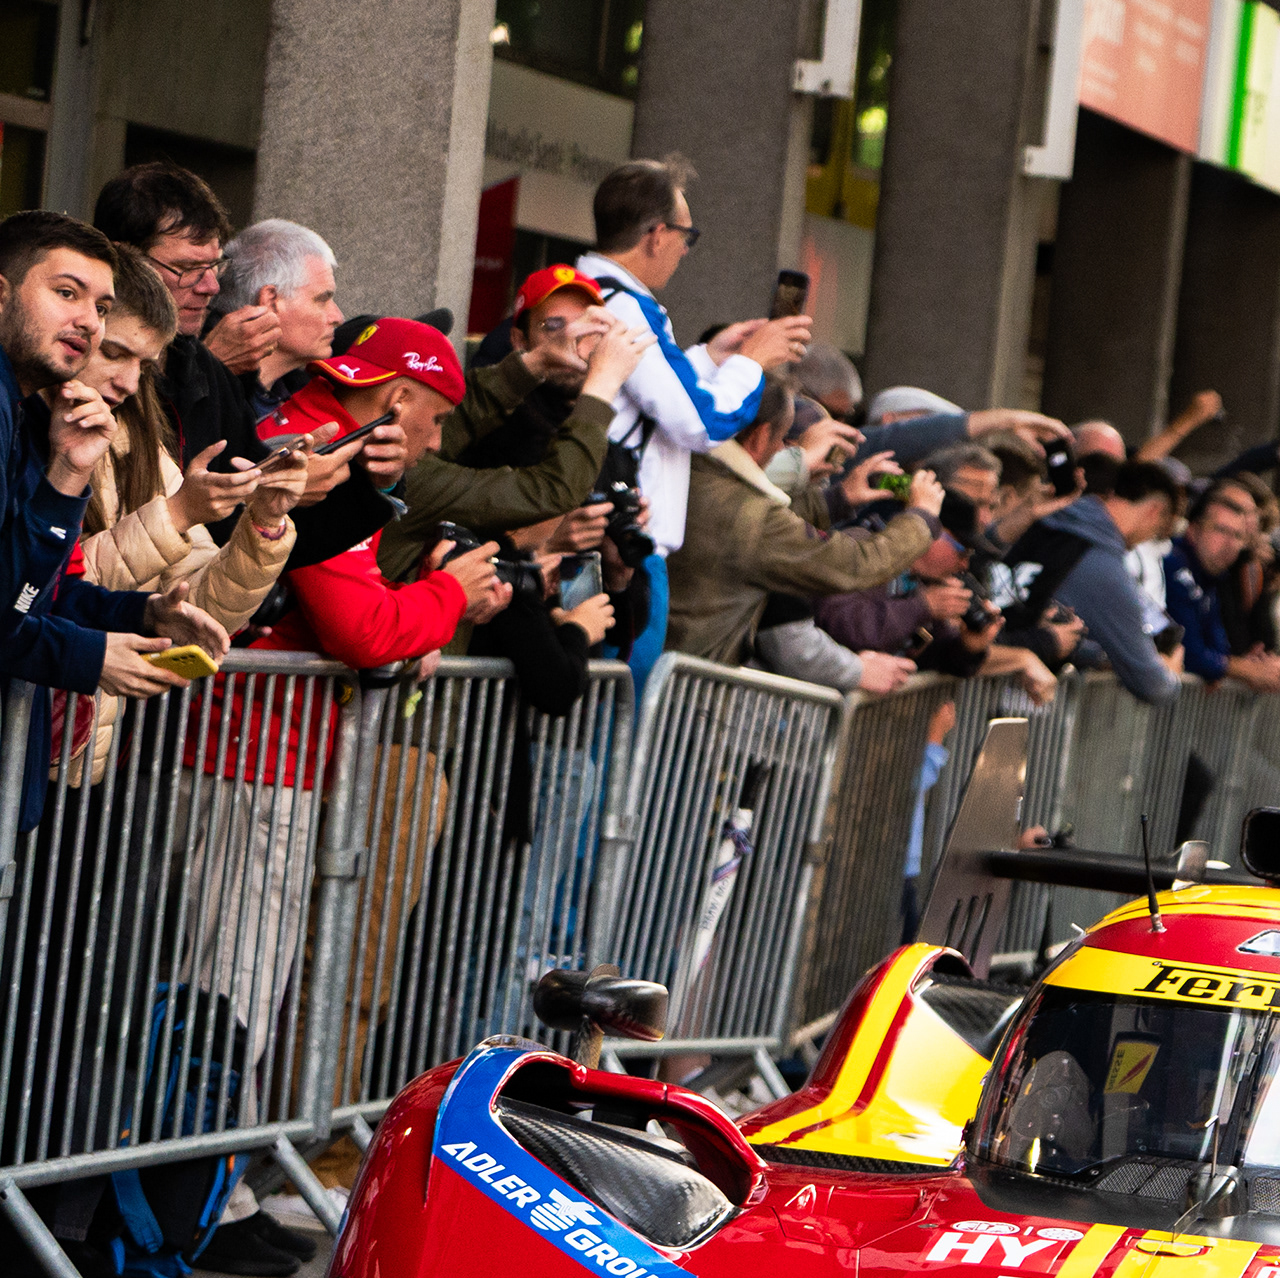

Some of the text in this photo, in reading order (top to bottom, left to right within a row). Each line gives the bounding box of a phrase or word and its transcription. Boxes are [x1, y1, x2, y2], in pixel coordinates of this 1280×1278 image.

[14, 582, 40, 613] NIKE
[441, 1141, 541, 1209] ADLER
[925, 1231, 1058, 1268] HY
